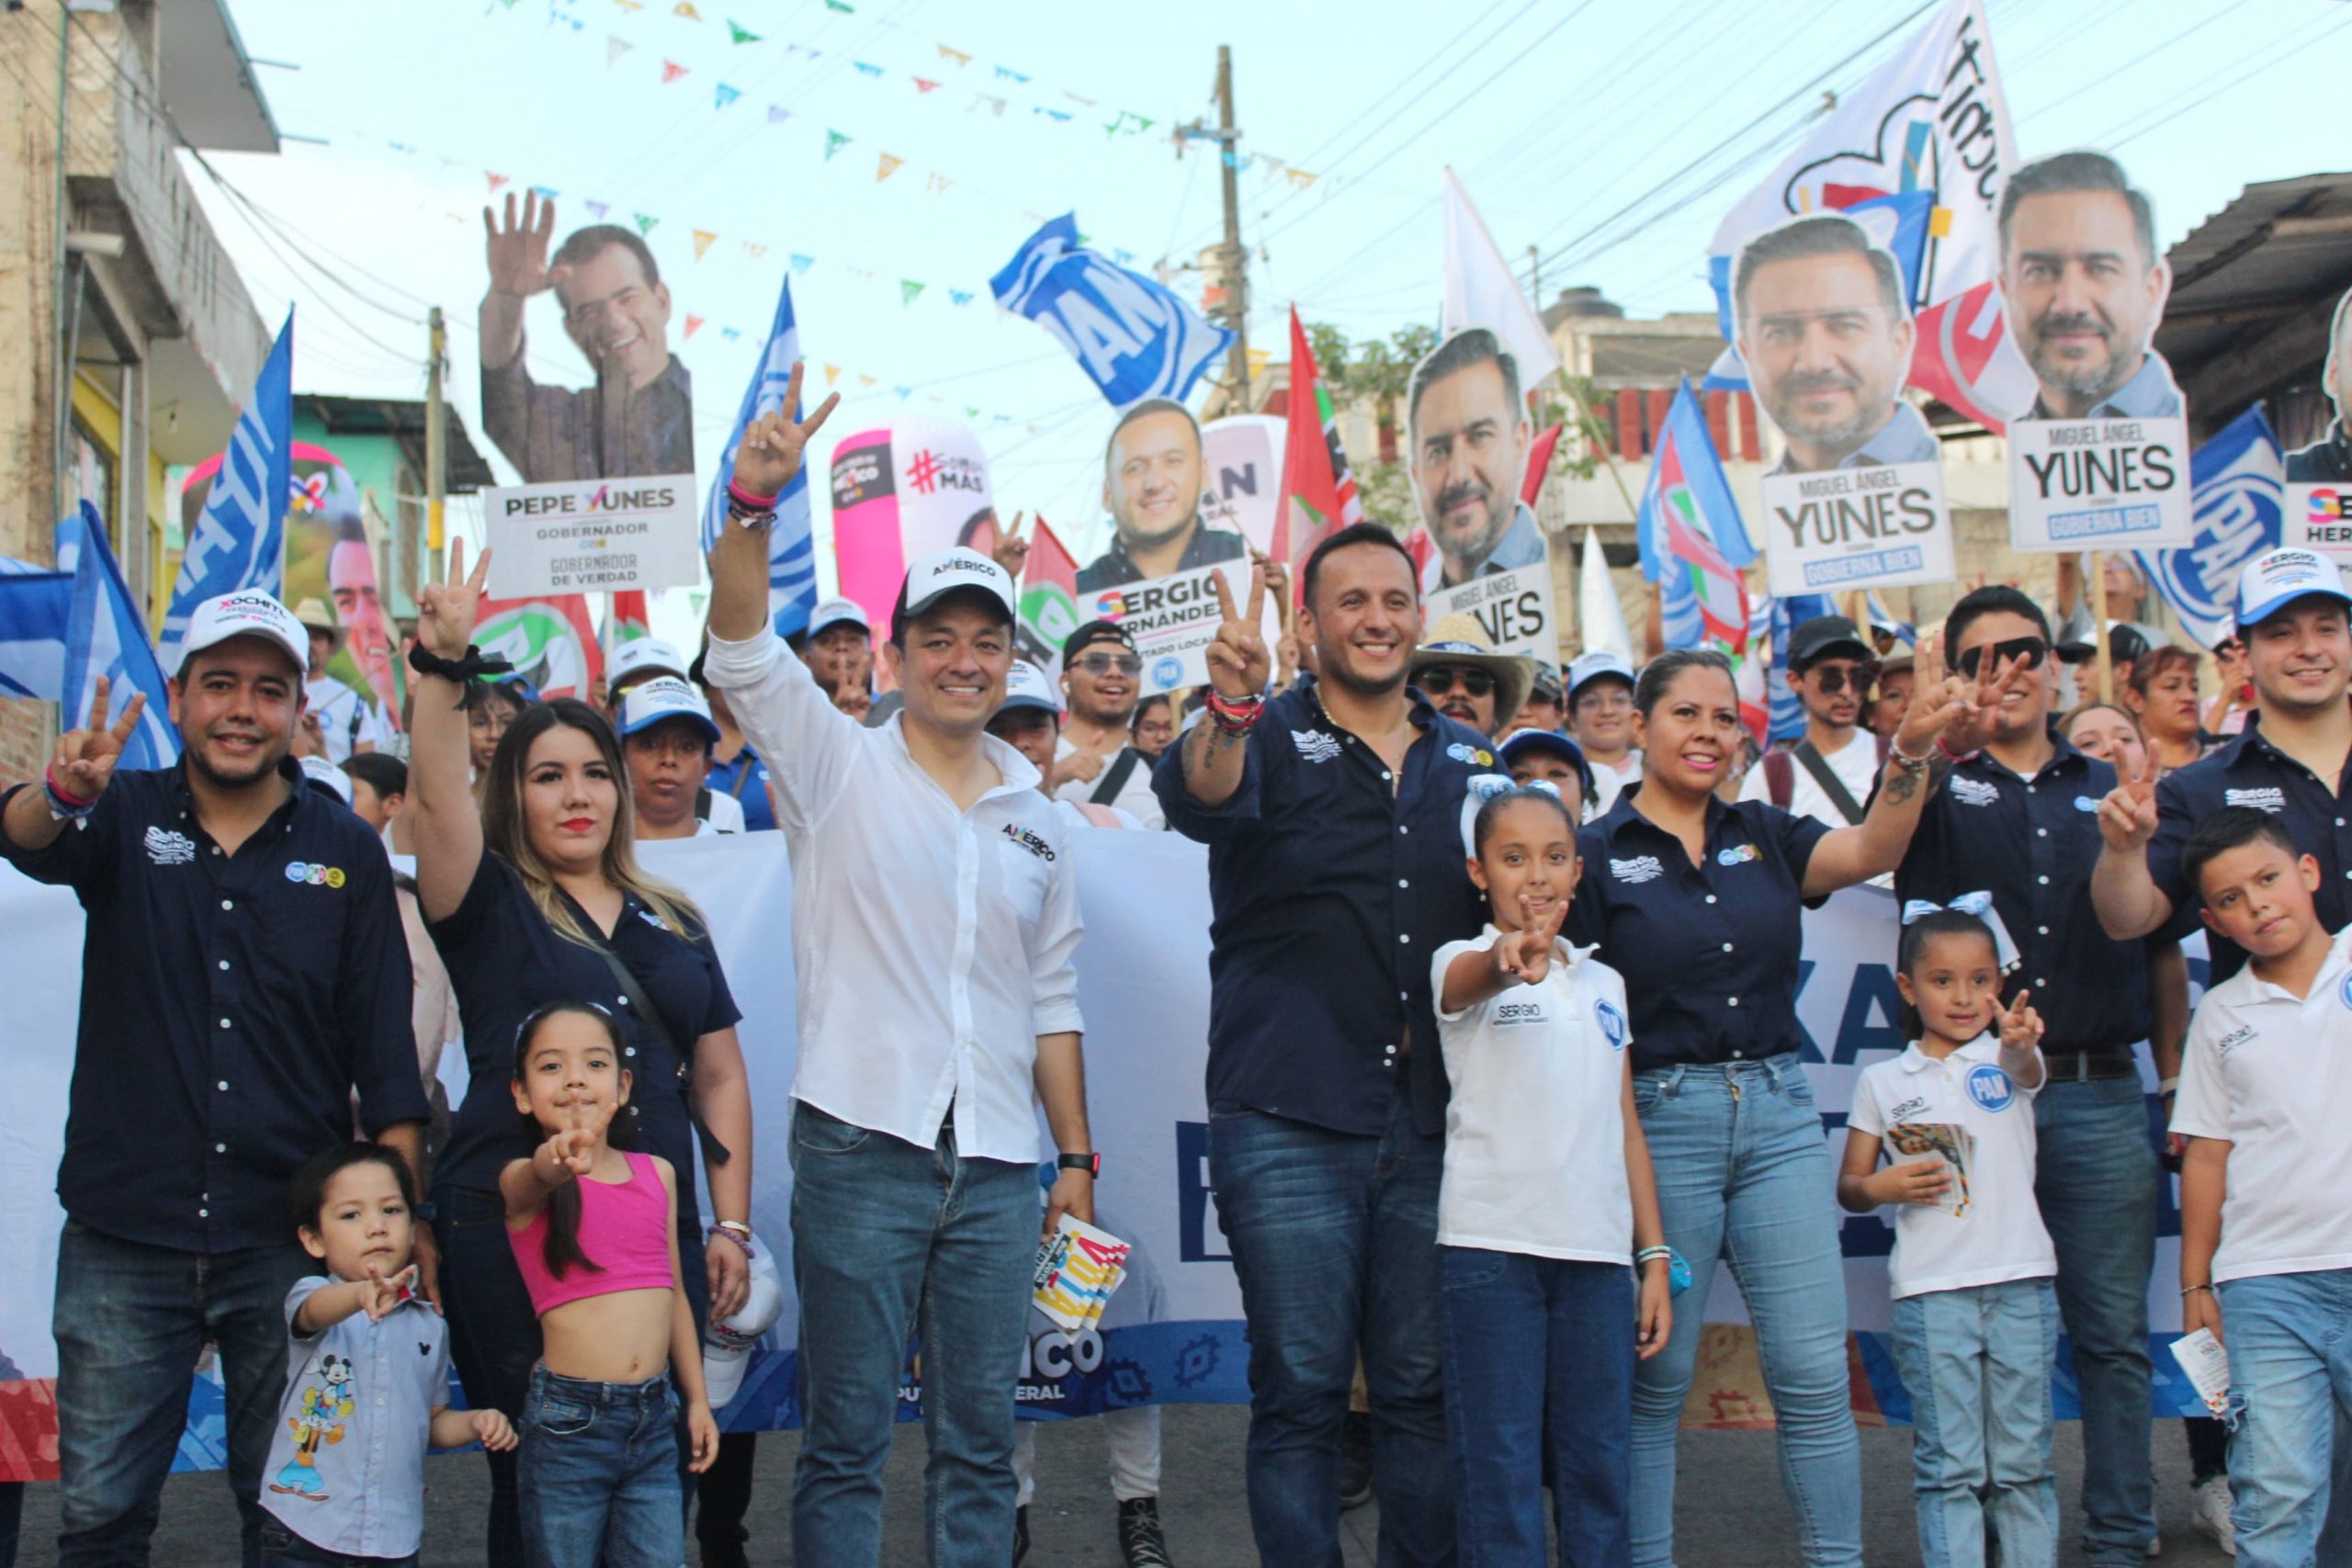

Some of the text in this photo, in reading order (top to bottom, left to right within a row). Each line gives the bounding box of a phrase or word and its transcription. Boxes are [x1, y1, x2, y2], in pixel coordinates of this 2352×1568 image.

[2048, 426, 2098, 446] MIGUEL
[2023, 445, 2176, 499] YUNES
[1799, 475, 1851, 499] MIGUEL
[505, 485, 675, 516] PEPE YUNES
[1774, 488, 1937, 548] YUNES
[537, 523, 649, 540] GOBERNADOR
[550, 553, 638, 574] GOBERNADOR
[933, 558, 996, 577] AMÉRICO
[551, 570, 638, 586] DE VERDAD
[1498, 1004, 1540, 1018] SERGIO
[1972, 1073, 2009, 1101] PAN
[1014, 1384, 1066, 1402] ERAL
